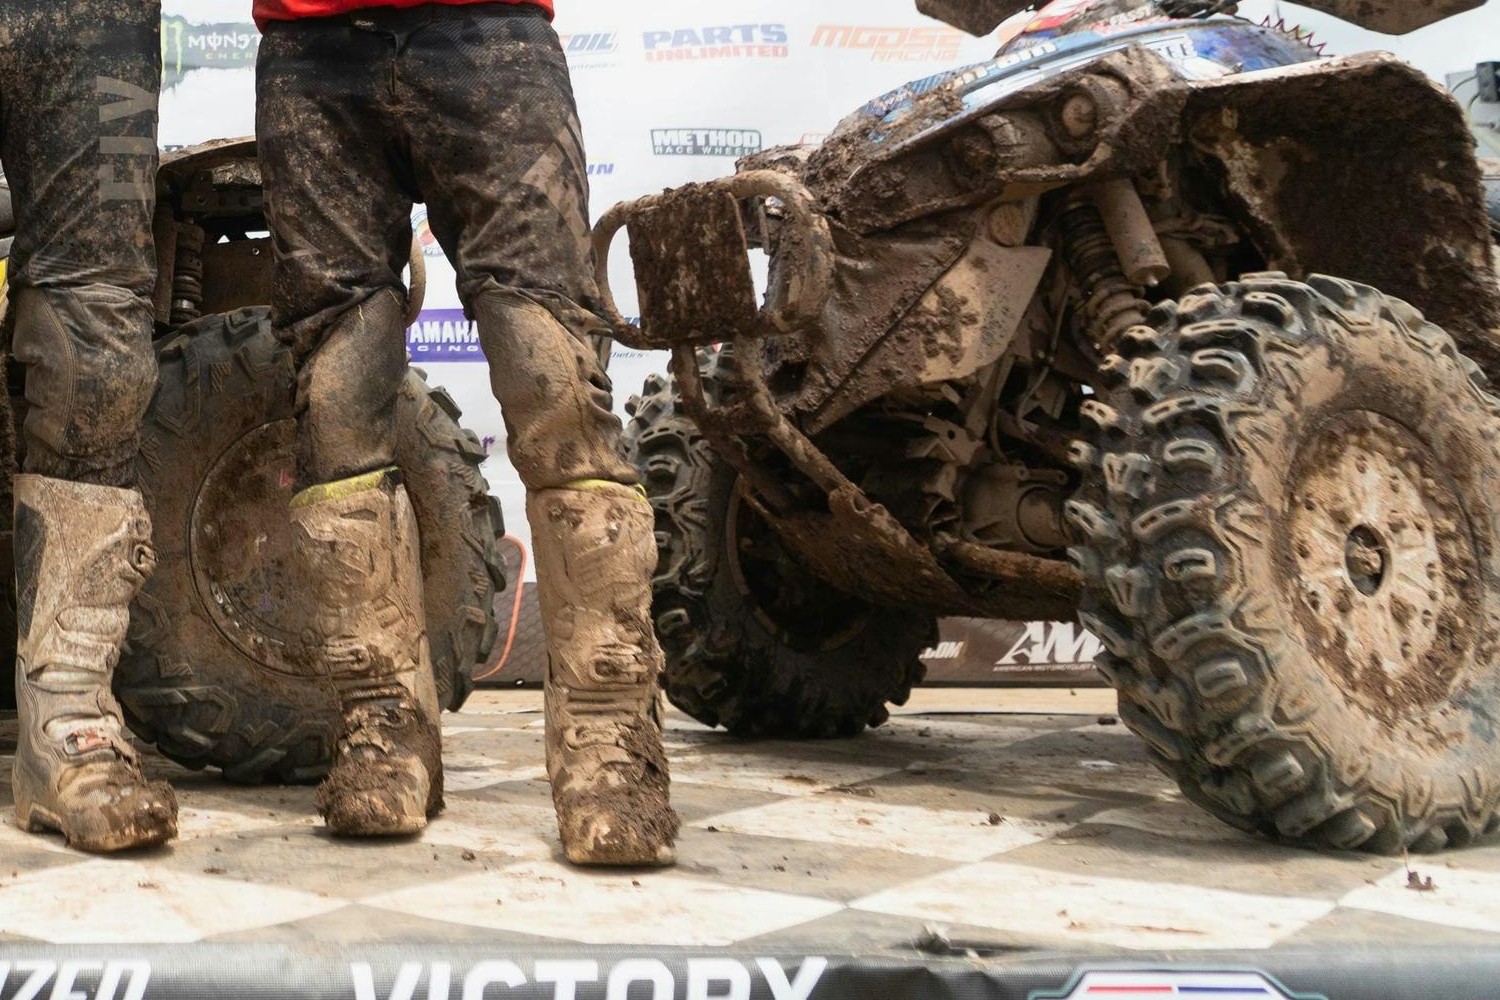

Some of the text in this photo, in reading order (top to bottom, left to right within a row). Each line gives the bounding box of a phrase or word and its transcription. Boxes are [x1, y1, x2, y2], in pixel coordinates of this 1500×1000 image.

[641, 22, 789, 50] PARTS
[809, 23, 963, 50] MOOSE
[644, 44, 789, 62] UNLIMITED
[870, 48, 959, 61] RACING
[654, 129, 761, 149] METHOD
